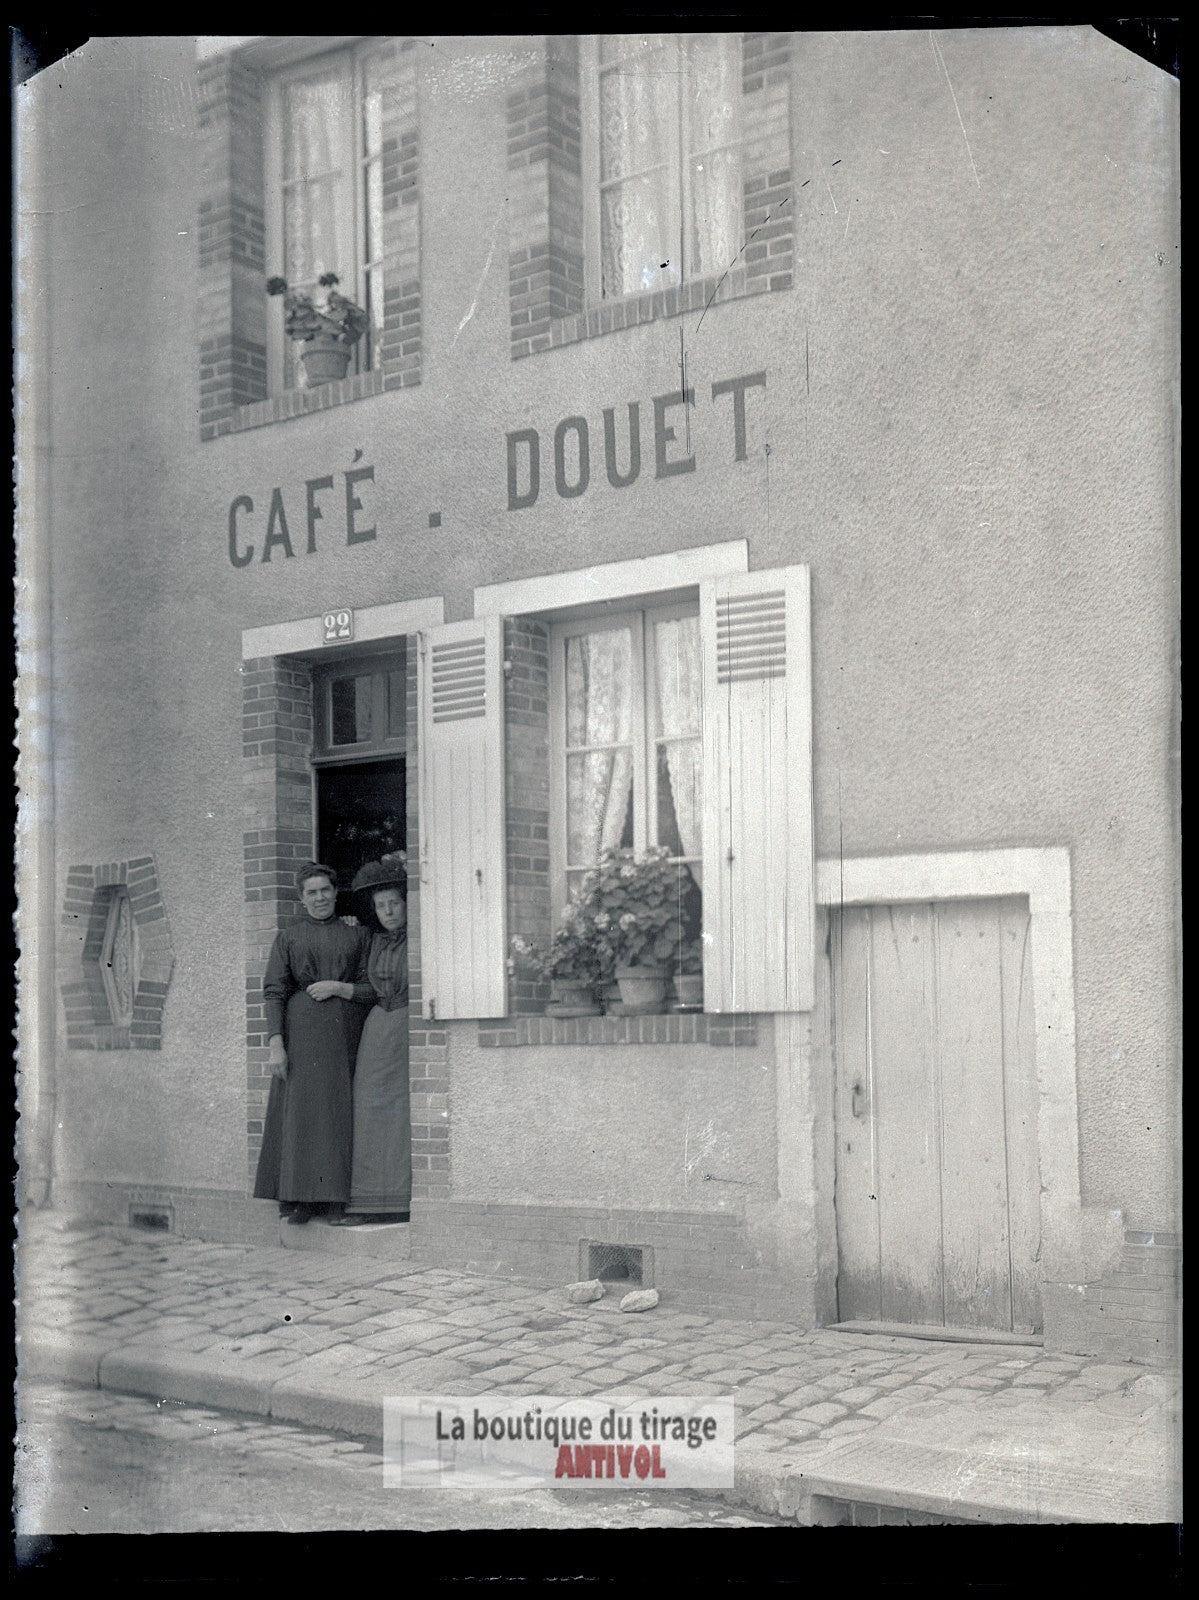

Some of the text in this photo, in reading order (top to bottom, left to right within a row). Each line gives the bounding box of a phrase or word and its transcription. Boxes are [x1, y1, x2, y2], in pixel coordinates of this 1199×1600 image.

[228, 448, 377, 568] CAFÉ
[505, 370, 767, 511] DOUET
[324, 612, 350, 639] 22
